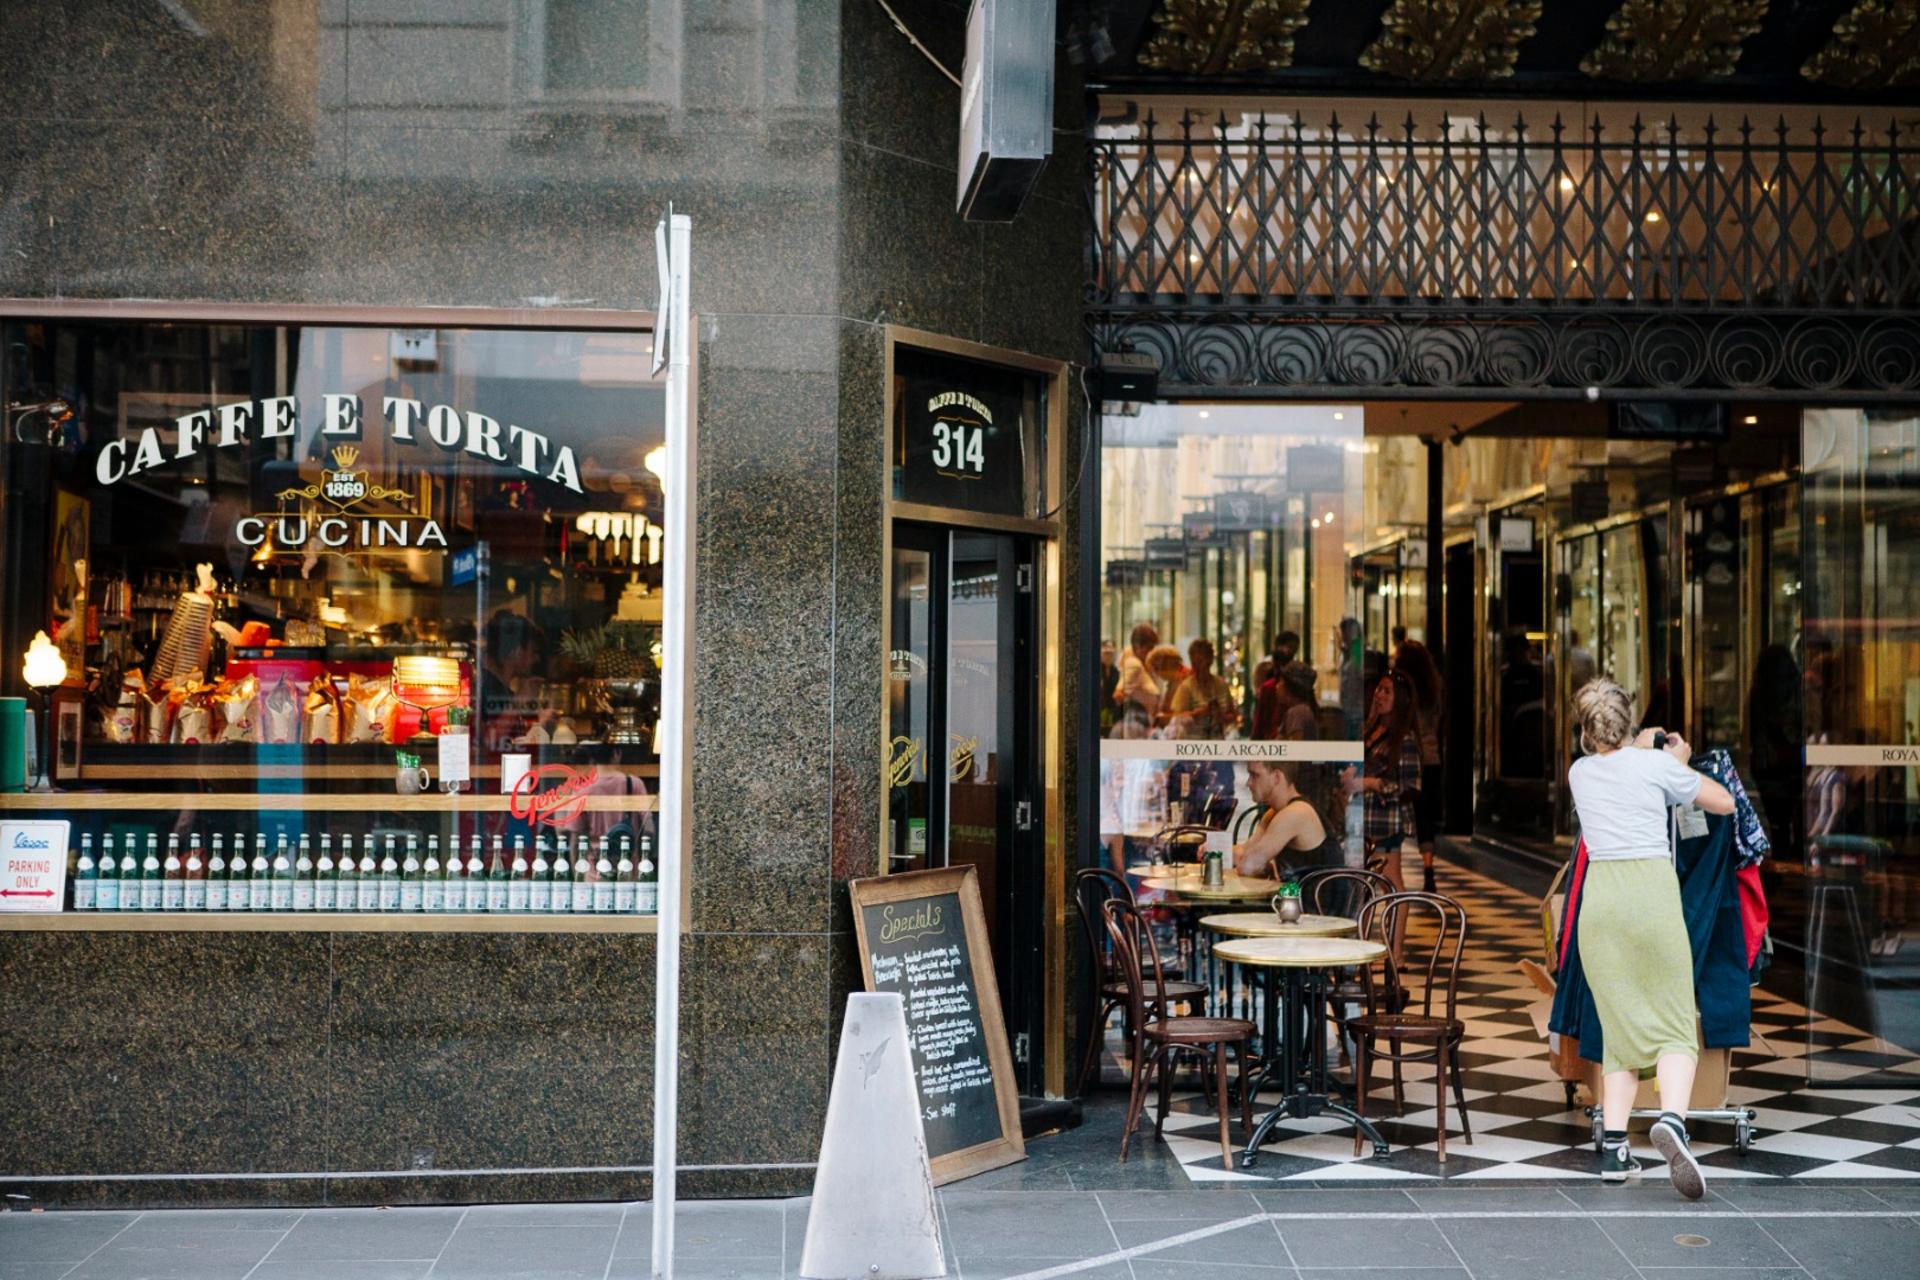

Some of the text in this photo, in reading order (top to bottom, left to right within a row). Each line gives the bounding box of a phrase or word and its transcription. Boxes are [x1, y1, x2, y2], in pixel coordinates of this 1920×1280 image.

[97, 394, 584, 494] CAFFE E TORTA
[932, 422, 985, 472] 314
[333, 474, 354, 482] EST
[326, 482, 364, 498] 1869
[236, 518, 448, 547] CUCINA
[1176, 744, 1288, 756] ROYAL ARCADE
[1882, 749, 1919, 761] ROYA
[8, 860, 50, 873] PARKING
[16, 876, 40, 888] ONLY
[880, 903, 942, 939] Specials
